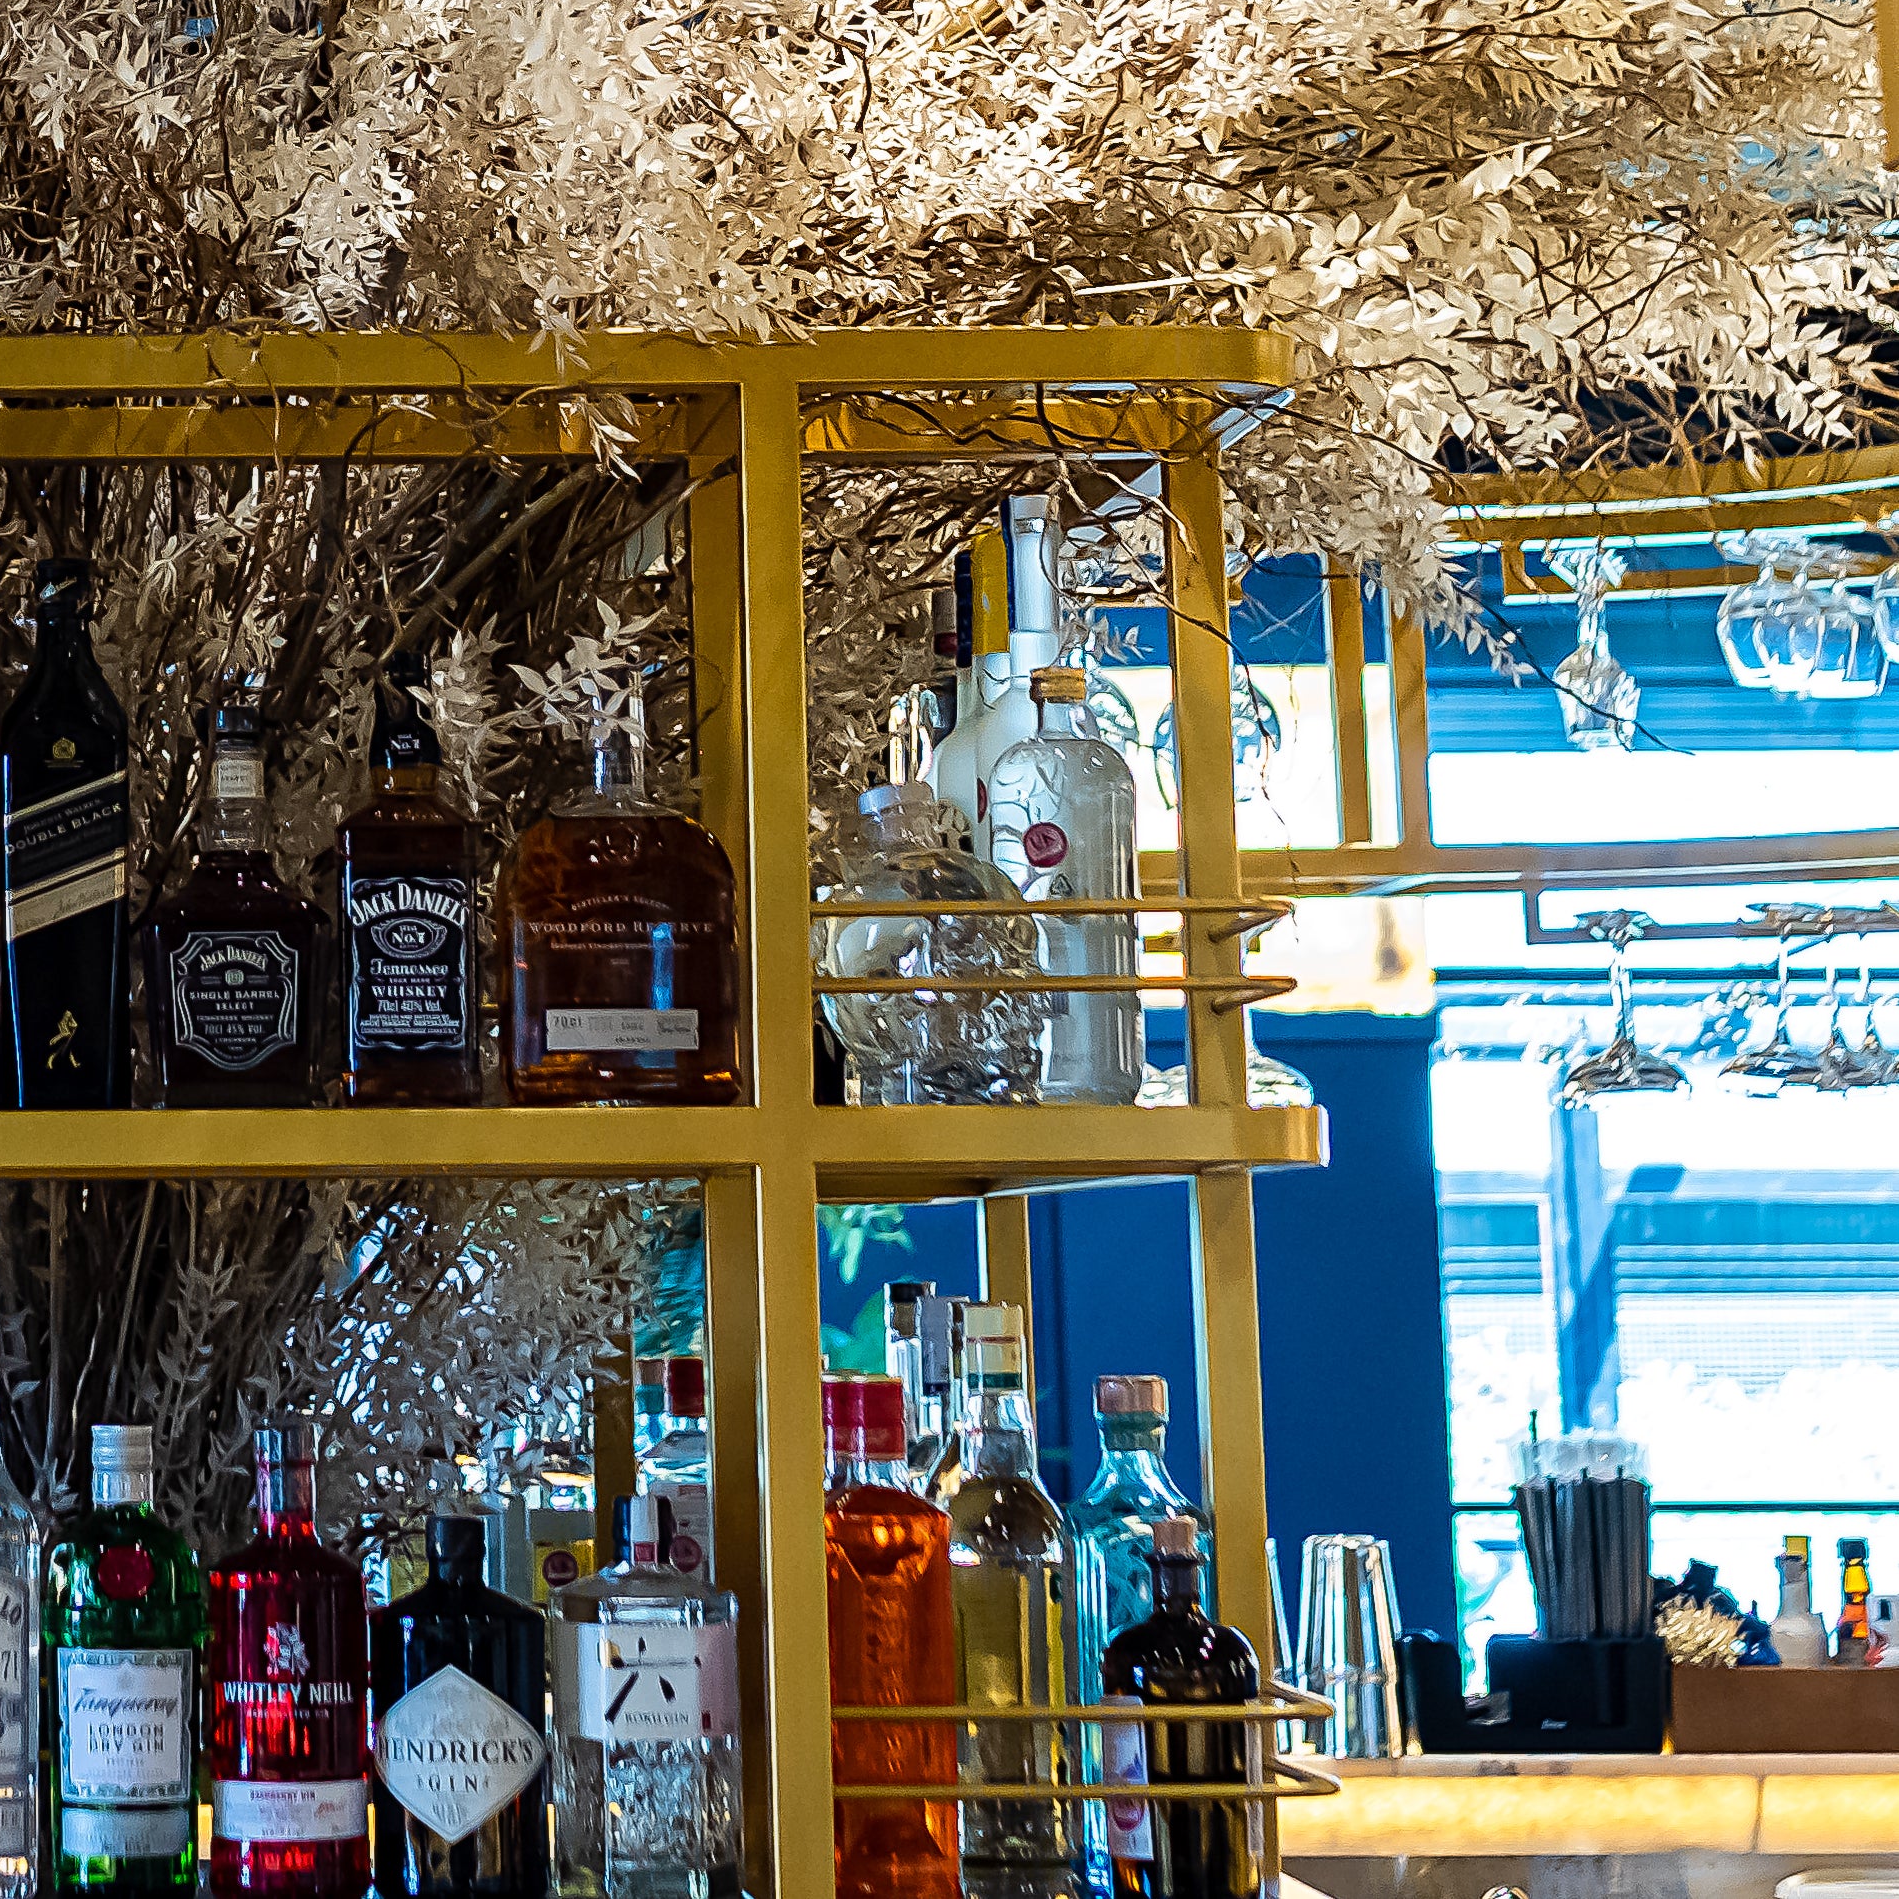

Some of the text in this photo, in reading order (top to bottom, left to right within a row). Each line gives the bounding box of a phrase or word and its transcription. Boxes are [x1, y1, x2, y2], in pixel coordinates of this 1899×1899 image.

[4, 823, 67, 855] DOUBLE
[71, 802, 125, 831] BLACK
[351, 882, 470, 928] JACK DANIEL'S
[528, 920, 627, 934] WOODFORD
[200, 949, 226, 971] JACK
[190, 990, 280, 1000] SINGLE BARREL
[371, 985, 448, 998] WHISKEY
[73, 1688, 178, 1719] Tanqueray
[223, 1681, 353, 1705] WHITLEY NEILL
[89, 1723, 164, 1737] LONDON
[89, 1738, 164, 1753] DRY GIN
[378, 1738, 535, 1764] HENDRICK'S
